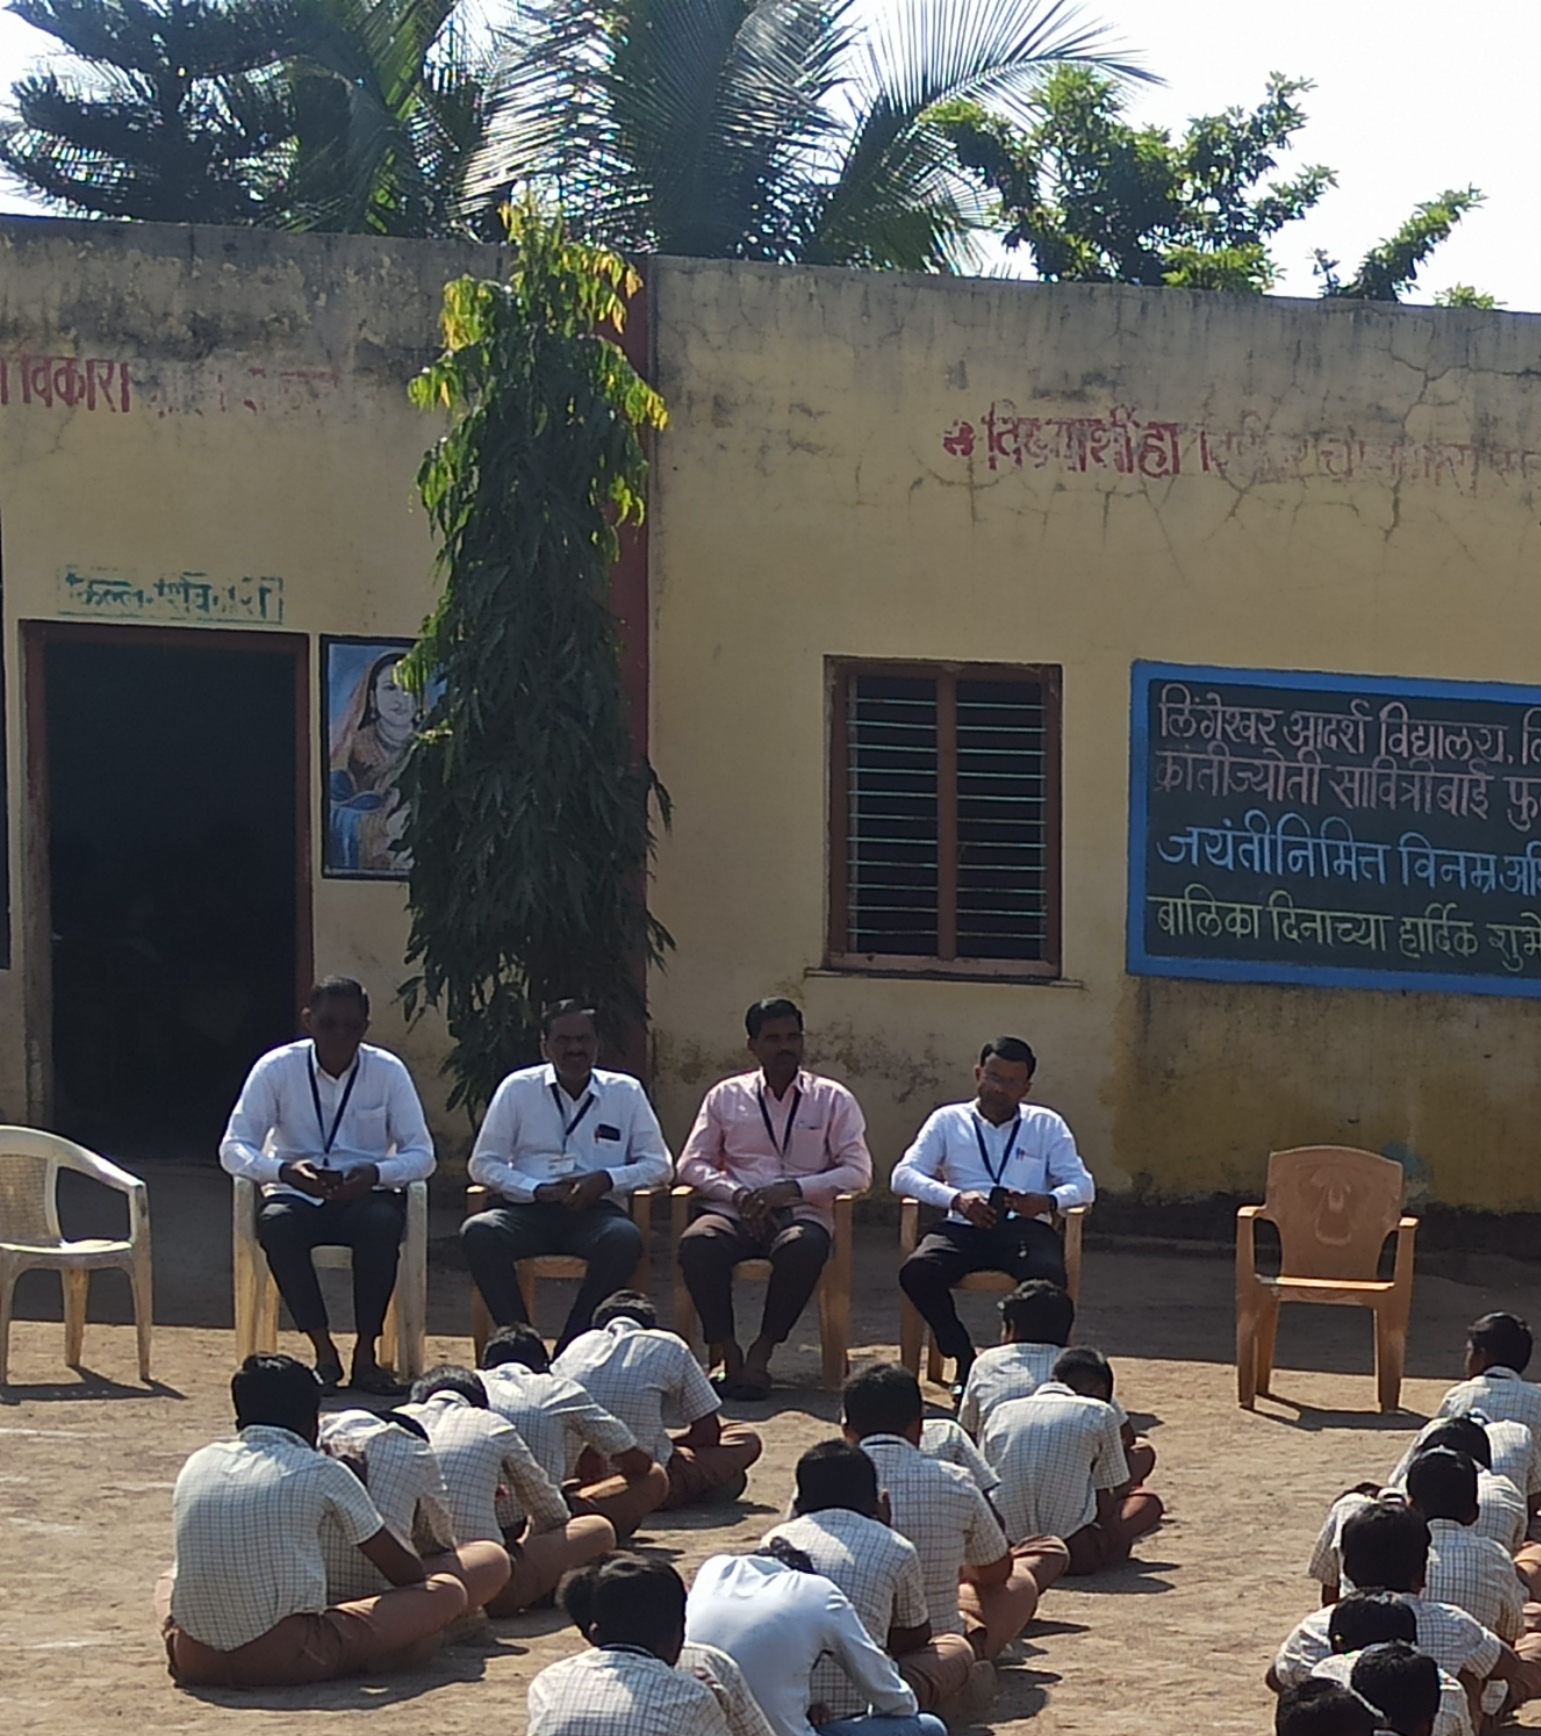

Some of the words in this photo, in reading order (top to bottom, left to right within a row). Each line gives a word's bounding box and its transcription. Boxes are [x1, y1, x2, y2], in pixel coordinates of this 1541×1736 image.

[1157, 683, 1284, 747] लिंगेश्वर
[1282, 699, 1373, 754] आदर्श
[1329, 756, 1495, 819] सावित्रीबाई
[1157, 809, 1392, 885] जयंतीनिमित्त
[1397, 832, 1498, 895] विनम्र
[1148, 884, 1262, 940] बालिका
[1266, 890, 1394, 951] दिनाच्या
[1398, 903, 1481, 958] हार्दिक
